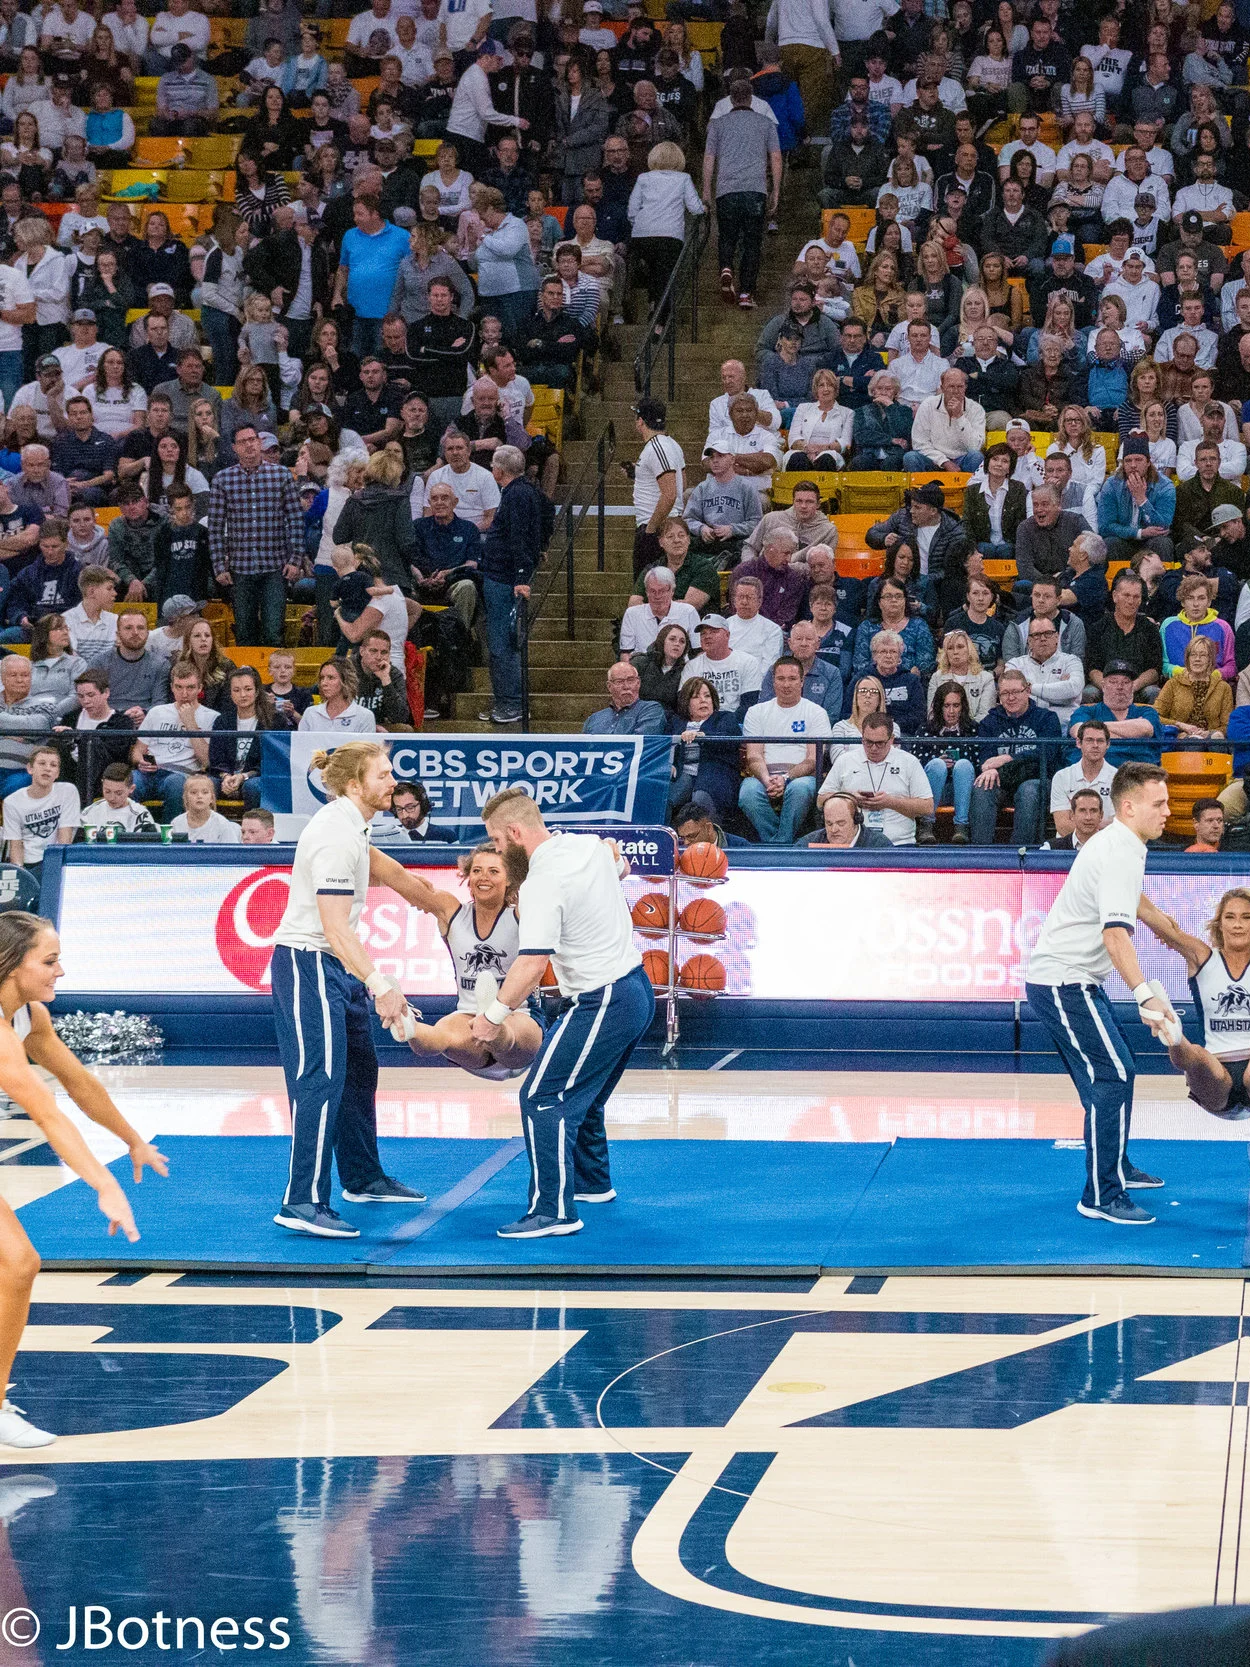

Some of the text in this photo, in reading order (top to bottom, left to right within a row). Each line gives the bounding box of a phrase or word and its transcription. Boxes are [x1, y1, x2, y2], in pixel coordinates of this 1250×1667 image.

[719, 496, 741, 510] STATE
[394, 748, 625, 779] CBS SPORTS
[25, 812, 43, 823] UTAH
[606, 838, 659, 855] tate
[1209, 1019, 1235, 1032] UTAH
